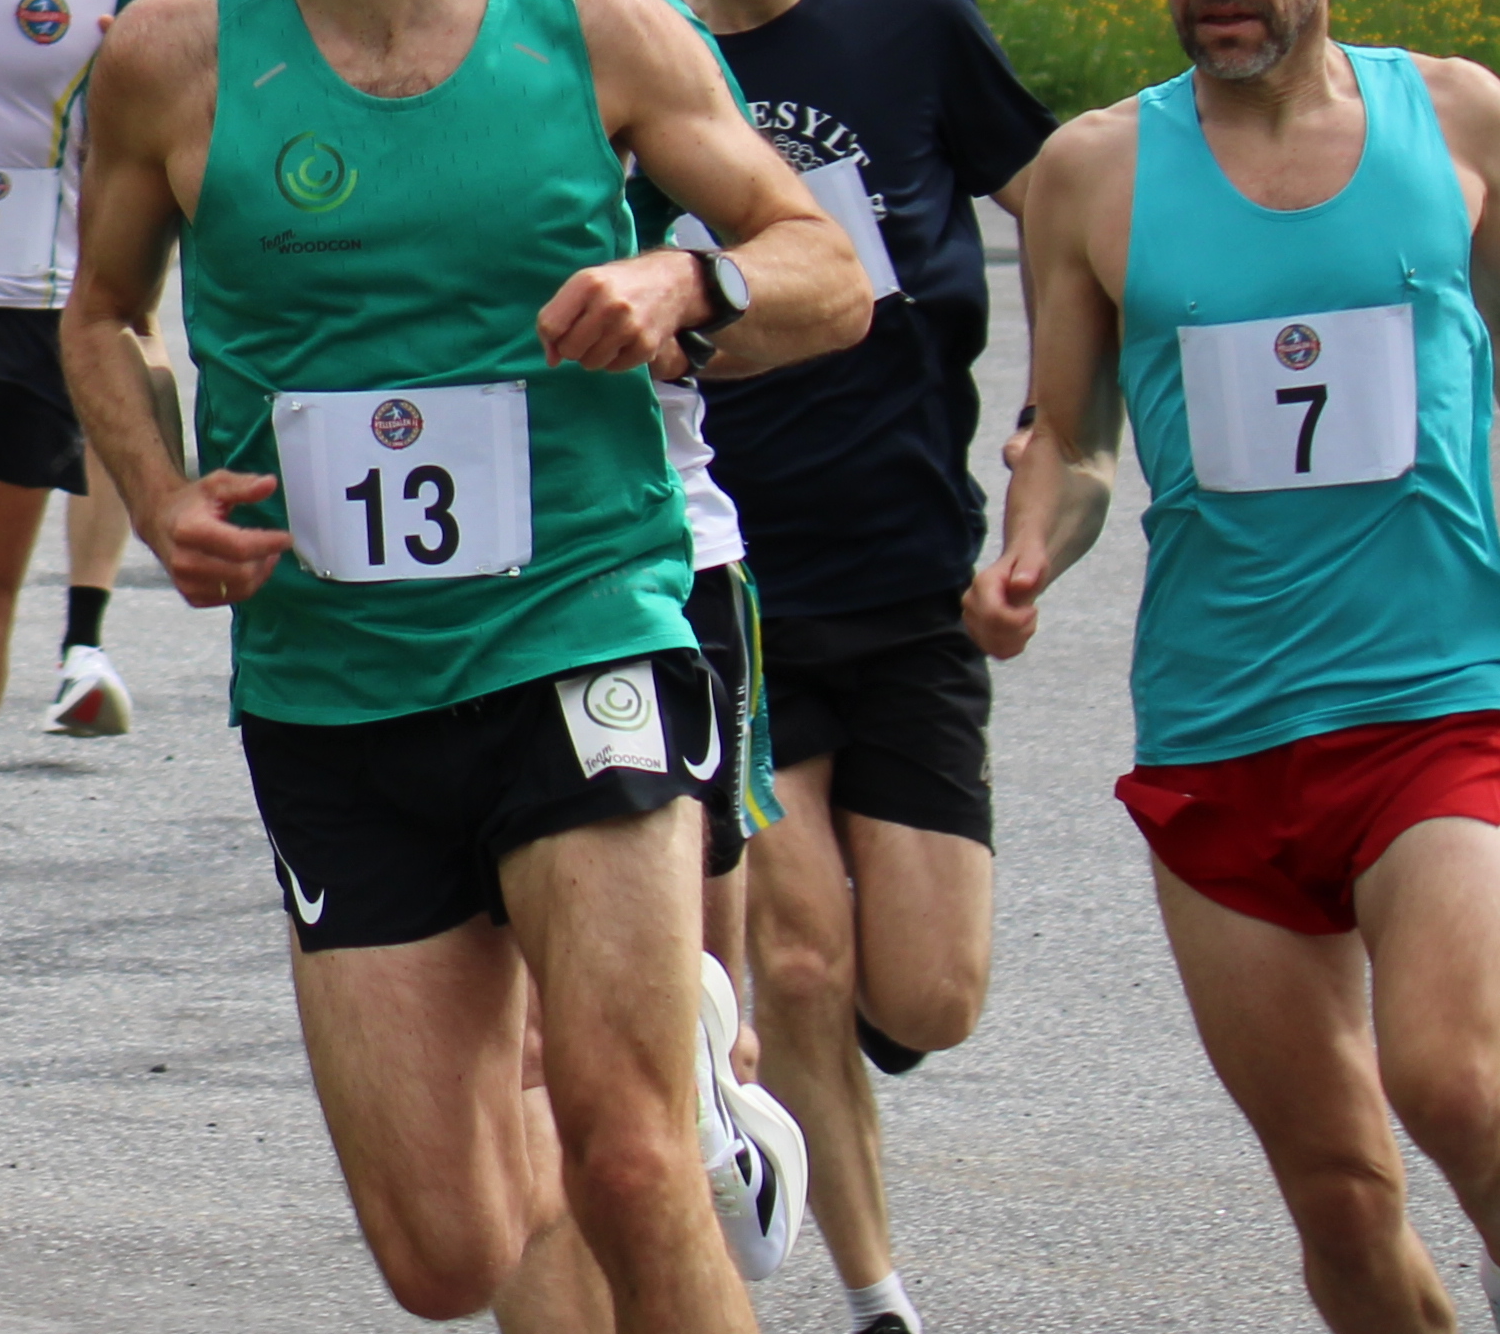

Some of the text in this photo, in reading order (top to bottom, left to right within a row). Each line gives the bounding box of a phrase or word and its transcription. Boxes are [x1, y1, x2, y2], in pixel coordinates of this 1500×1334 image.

[260, 228, 297, 251] Team
[280, 239, 362, 254] WOODCON
[1276, 384, 1327, 474] 7
[345, 465, 460, 566] 13
[585, 744, 615, 771] Team
[601, 754, 661, 769] WOODCON
